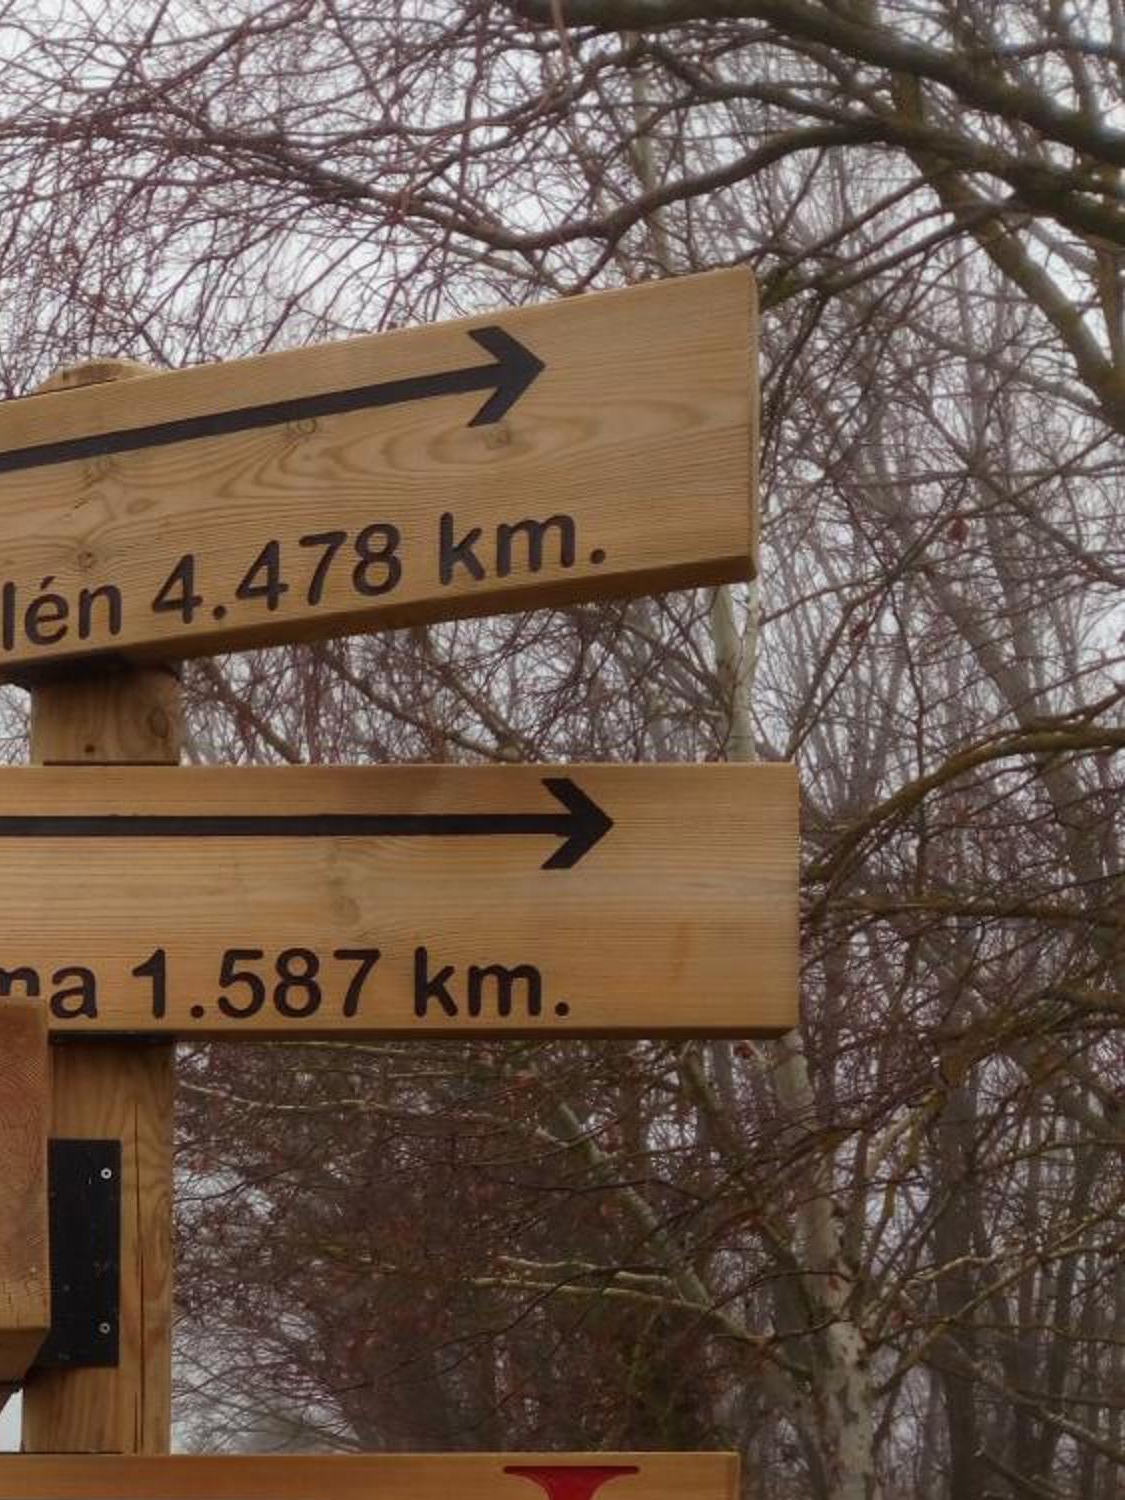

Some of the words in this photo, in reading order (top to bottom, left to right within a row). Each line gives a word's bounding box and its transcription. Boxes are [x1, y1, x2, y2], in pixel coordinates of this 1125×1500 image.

[150, 523, 404, 626] 4.478
[438, 511, 607, 588] km.
[131, 947, 383, 1021] 1.587
[411, 945, 572, 1020] km.
